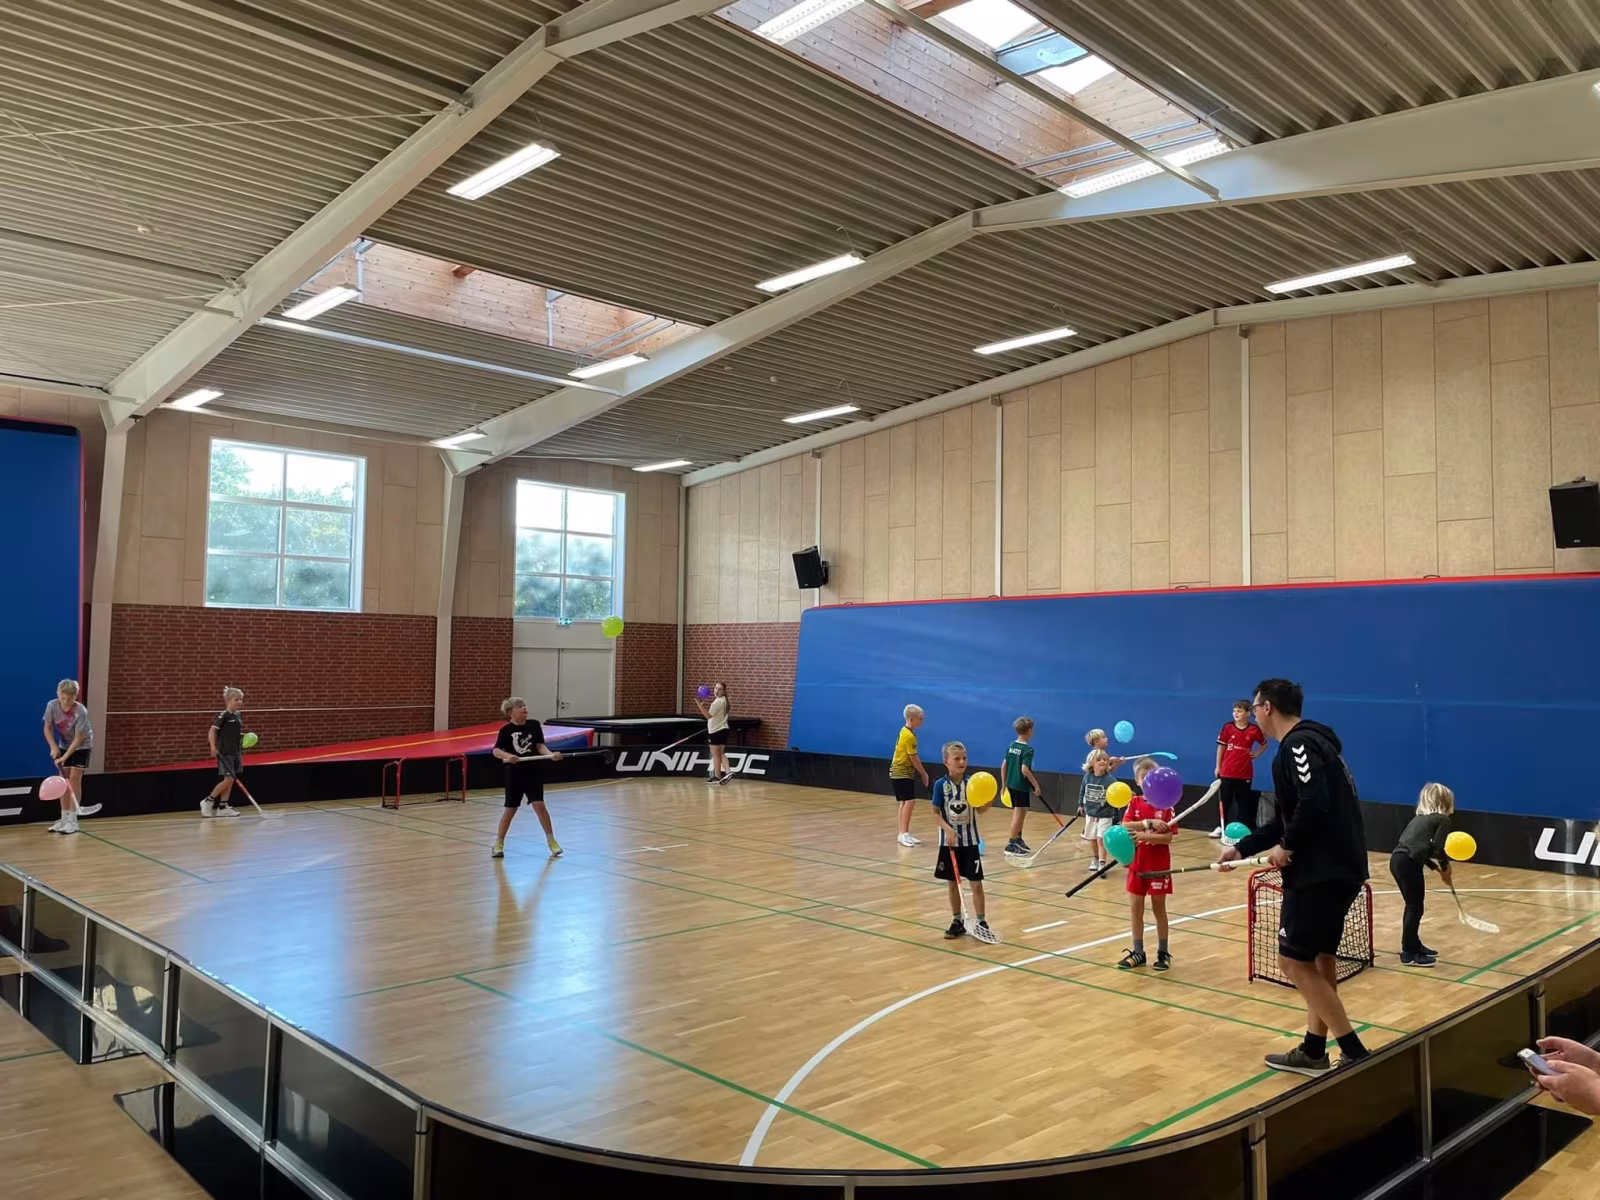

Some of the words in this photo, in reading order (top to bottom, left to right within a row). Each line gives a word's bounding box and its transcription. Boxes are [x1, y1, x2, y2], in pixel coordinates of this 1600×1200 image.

[616, 751, 770, 775] UNIHOC
[1534, 827, 1600, 866] U
[974, 859, 980, 874] 7
